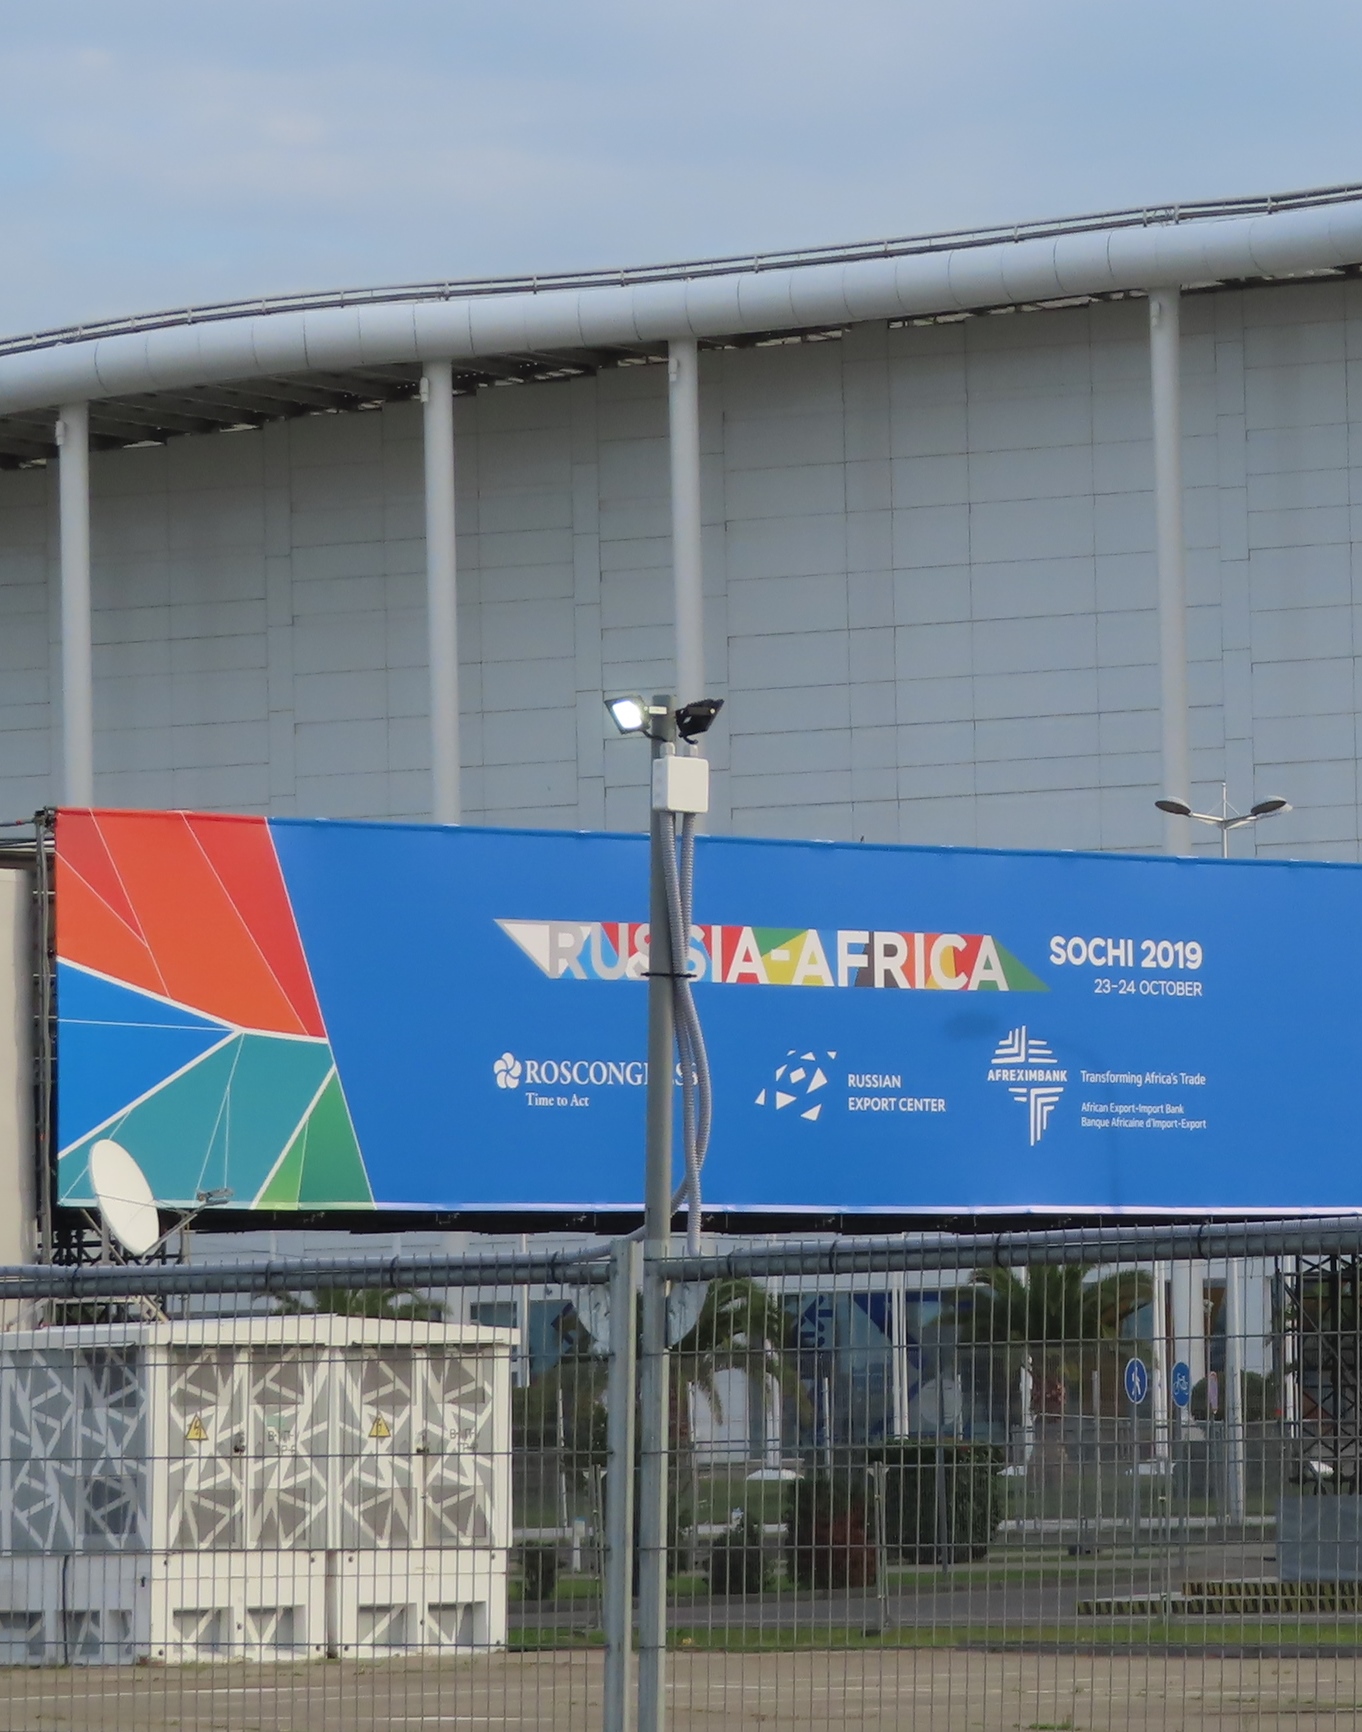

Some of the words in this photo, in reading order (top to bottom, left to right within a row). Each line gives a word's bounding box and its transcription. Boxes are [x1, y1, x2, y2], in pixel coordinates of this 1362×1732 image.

[1050, 936, 1133, 967] SOCHI
[1141, 940, 1203, 970] 2019
[1094, 979, 1136, 994] 23-24
[1139, 980, 1203, 997] OCTOBER
[848, 1074, 901, 1088] RUSSIAN
[987, 1069, 1067, 1082] AFREXIMBANK
[1080, 1070, 1142, 1087] Transforming
[1144, 1071, 1178, 1085] Africa's
[1179, 1073, 1206, 1085] Trade
[526, 1092, 554, 1106] Time
[557, 1097, 568, 1106] to
[570, 1093, 590, 1107] Act
[848, 1097, 897, 1112] EXPORT
[899, 1098, 946, 1112] CENTER
[1081, 1102, 1108, 1112] African
[1110, 1103, 1164, 1115] Export-Import
[1165, 1104, 1184, 1114] Bank
[1081, 1117, 1110, 1129] Banque
[1111, 1117, 1144, 1128] Africaine
